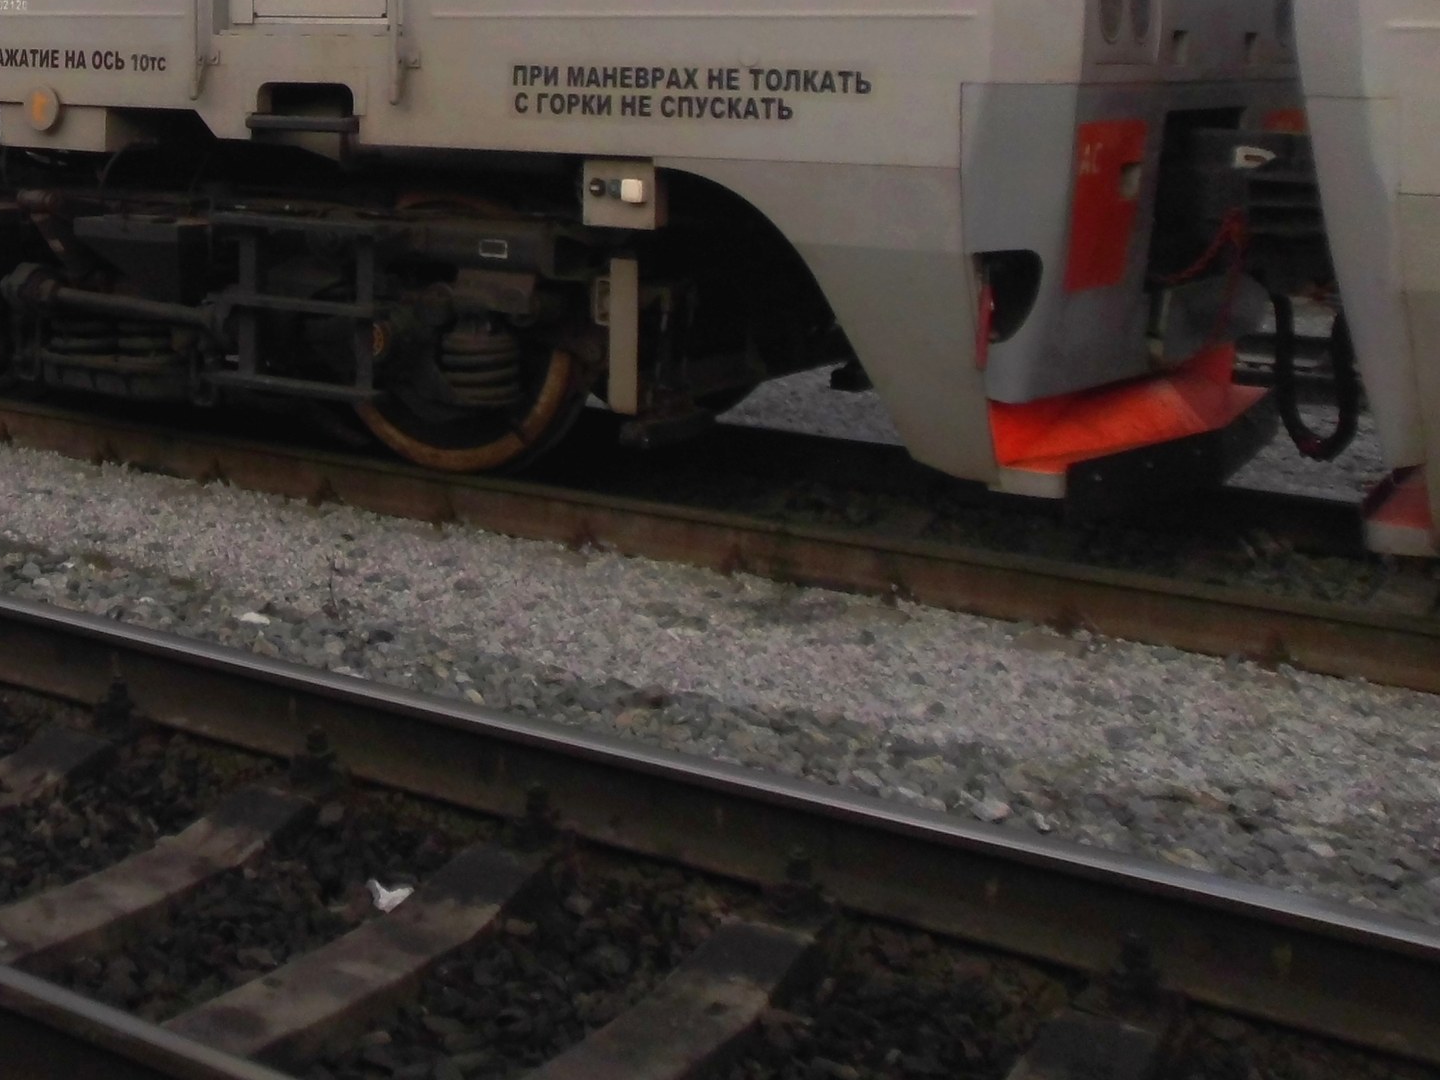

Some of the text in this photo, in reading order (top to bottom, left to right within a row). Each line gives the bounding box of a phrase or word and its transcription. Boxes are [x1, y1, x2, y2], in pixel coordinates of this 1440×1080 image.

[65, 50, 87, 69] НА
[92, 50, 125, 70] ОСЬ
[513, 65, 872, 95] ПРИ МАНЕВРАХ НЕ ТОЛКАТЬ
[514, 92, 794, 120] С ГОРКИ НЕ СПУСКАТЬ
